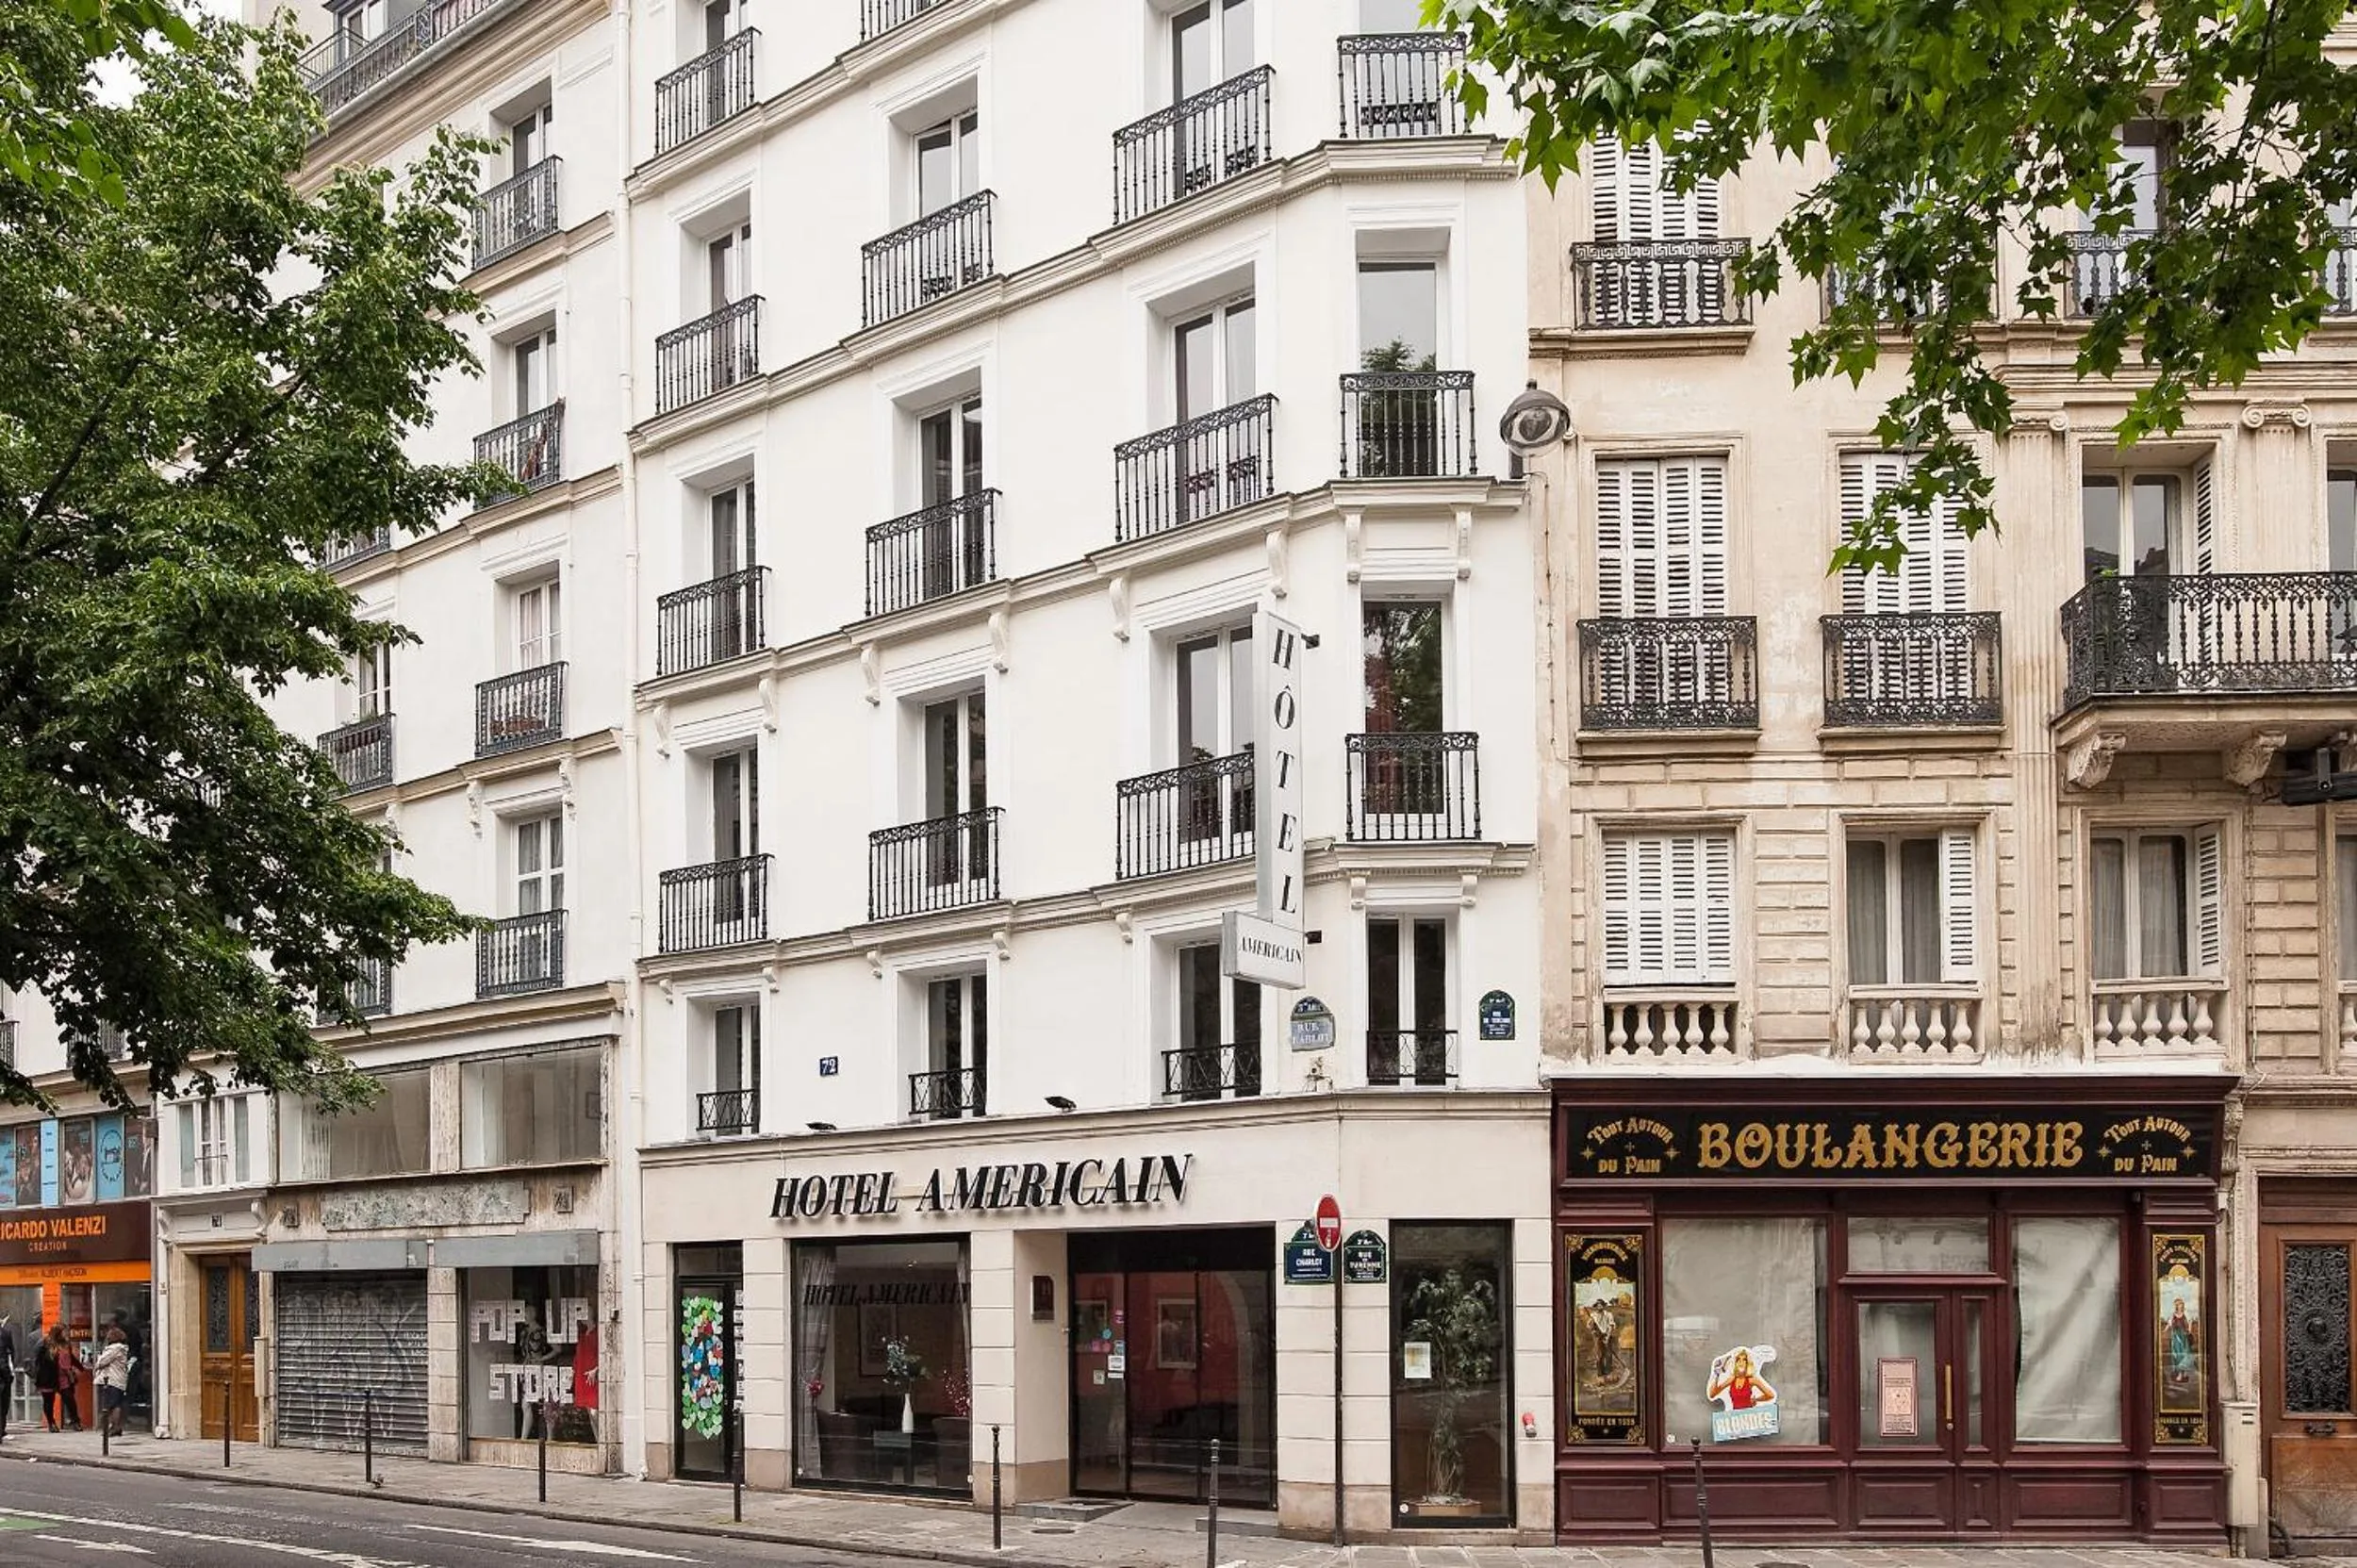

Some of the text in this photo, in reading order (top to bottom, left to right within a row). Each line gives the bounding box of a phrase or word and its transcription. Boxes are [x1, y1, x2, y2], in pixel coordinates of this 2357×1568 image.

[1273, 628, 1298, 915] HÔTEL
[1239, 936, 1302, 963] AMERICAIN
[821, 1058, 836, 1074] 72
[1697, 1121, 2084, 1169] BOULANGERIE
[1597, 1159, 1618, 1173] DU
[2114, 1157, 2134, 1172] DU
[769, 1153, 1194, 1218] HOTEL AMERICAIN
[51, 1214, 107, 1238] VALENZI
[470, 1299, 526, 1345] POP
[545, 1296, 589, 1345] UP
[487, 1362, 575, 1405] STORE
